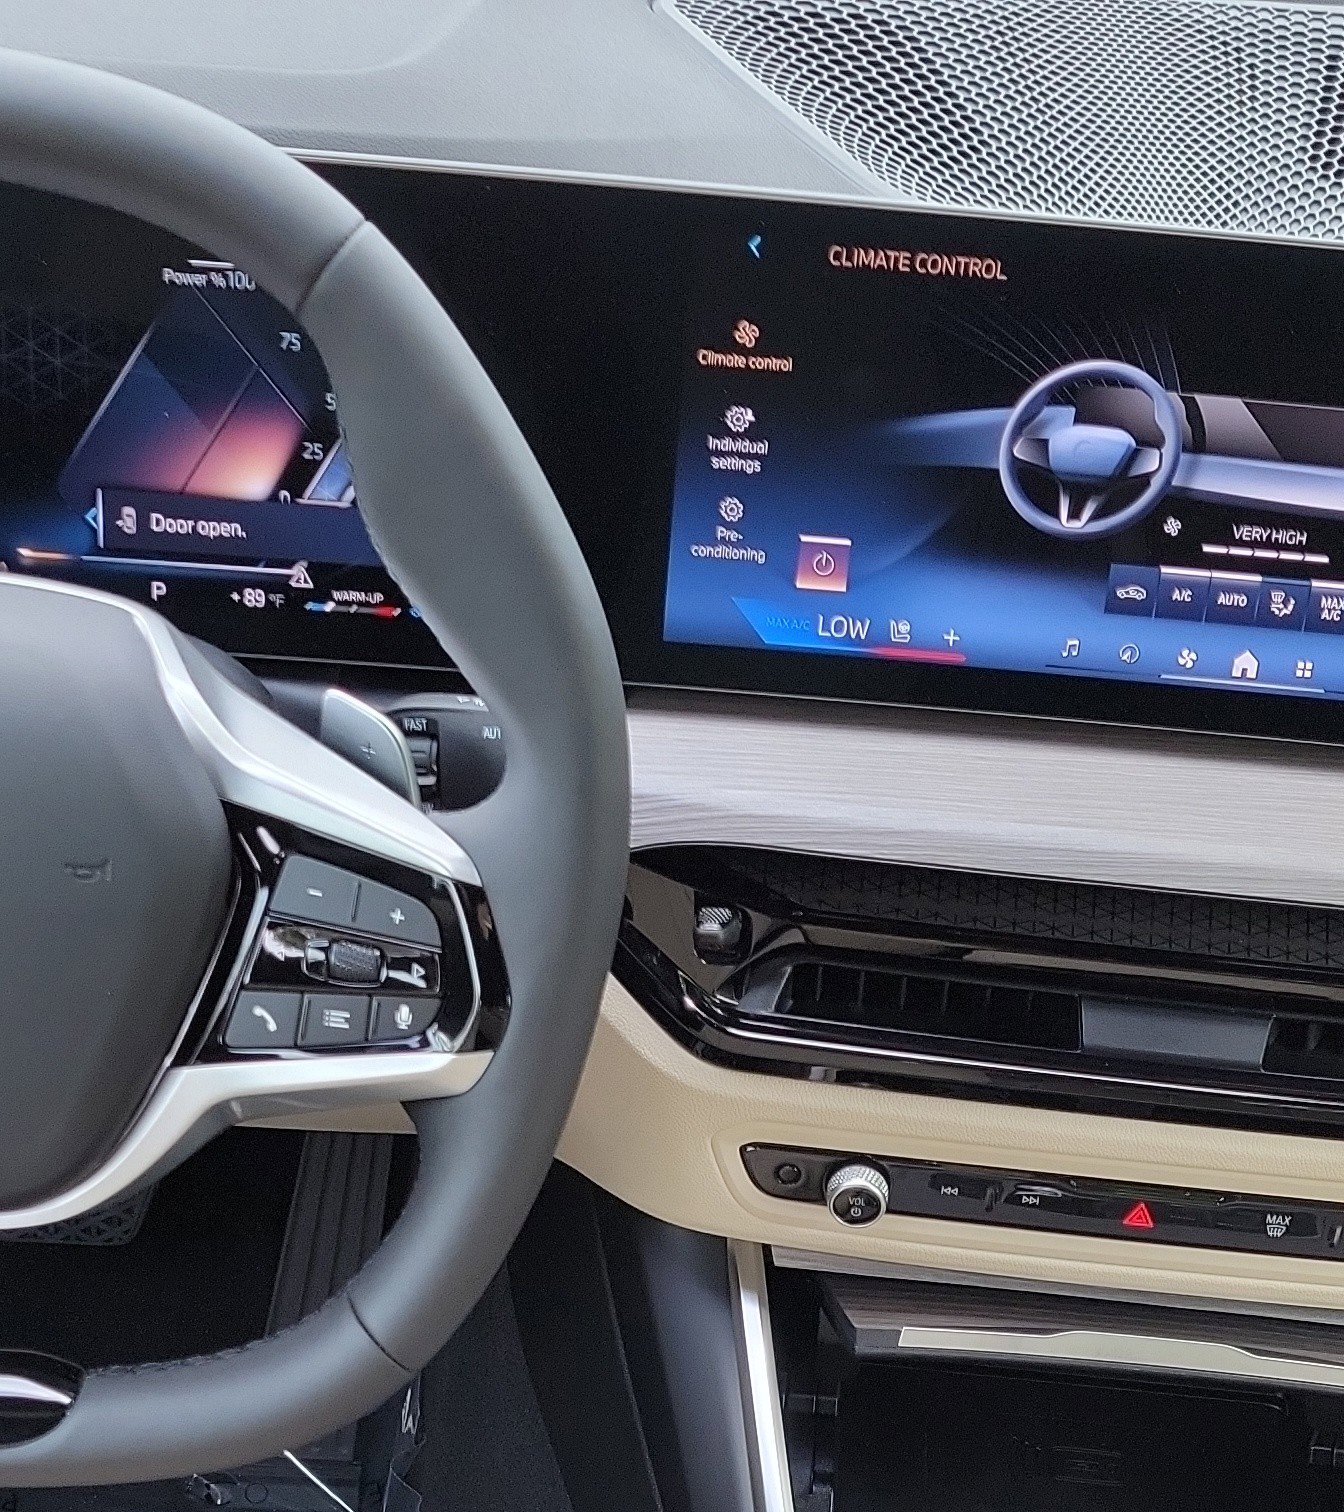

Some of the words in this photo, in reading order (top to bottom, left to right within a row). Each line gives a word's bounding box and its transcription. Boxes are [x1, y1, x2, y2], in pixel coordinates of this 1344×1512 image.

[829, 244, 910, 273] CLIMATE
[914, 253, 1007, 281] CONTROL
[163, 268, 207, 287] Power
[279, 332, 301, 351] 75
[697, 349, 746, 368] Climate
[749, 356, 793, 372] control
[302, 442, 323, 461] 25
[707, 435, 768, 455] Individual
[711, 455, 761, 474] settings
[150, 513, 195, 535] Door
[197, 516, 246, 539] open.
[717, 526, 743, 542] Pre-
[1232, 524, 1271, 541] VERY
[1271, 528, 1307, 546] HIGH
[691, 545, 766, 564] conditioning
[150, 582, 167, 600] P
[231, 588, 266, 608] +89
[332, 590, 385, 603] WARM-UP
[1172, 587, 1192, 602] A/C
[1217, 591, 1247, 607] AUTO
[1321, 609, 1341, 621] A/C
[818, 614, 871, 640] LOW
[404, 718, 429, 732] FAST
[848, 1196, 866, 1207] VOL
[1265, 1214, 1292, 1226] MAX
